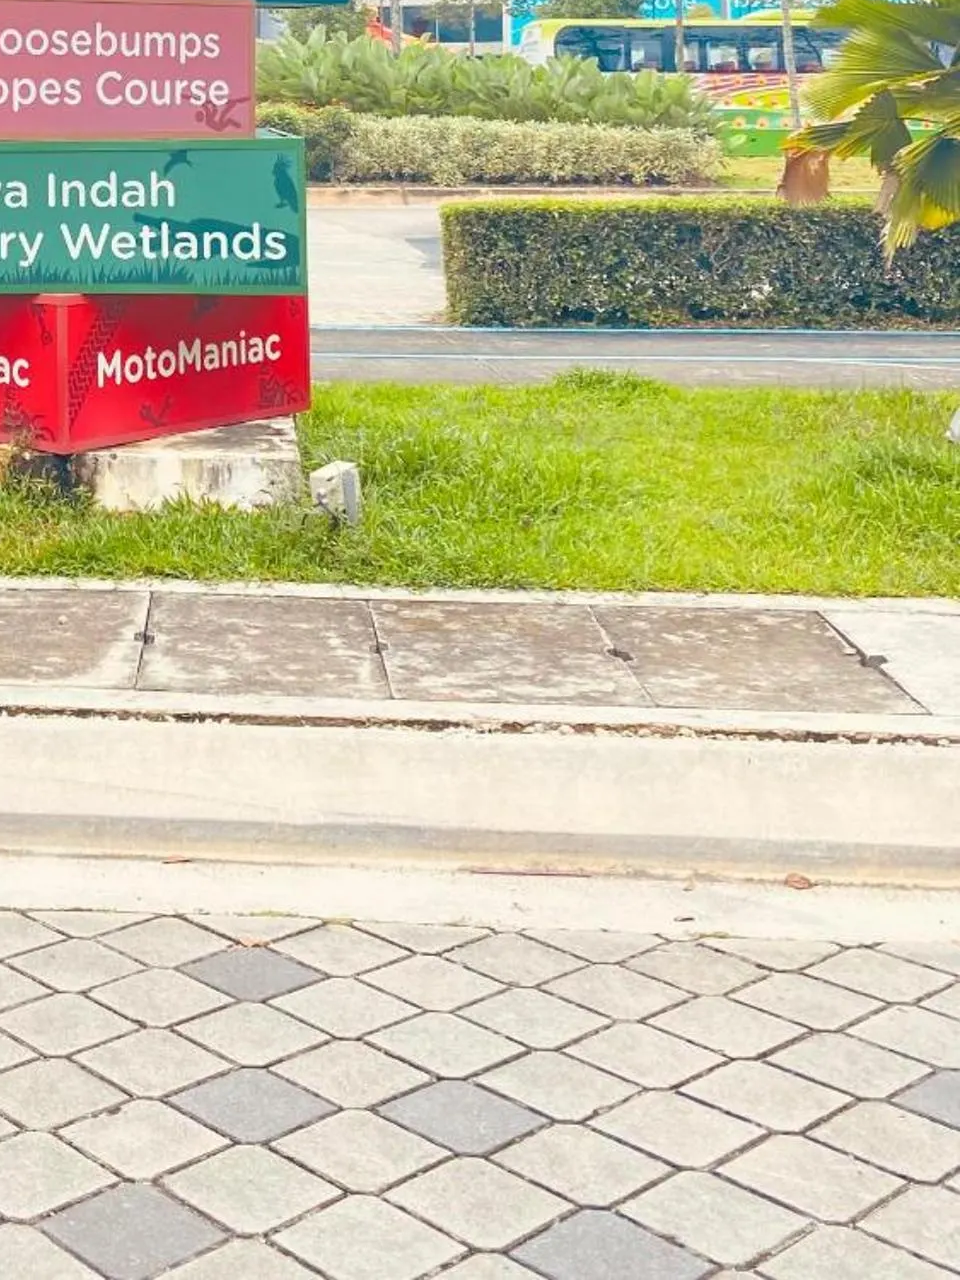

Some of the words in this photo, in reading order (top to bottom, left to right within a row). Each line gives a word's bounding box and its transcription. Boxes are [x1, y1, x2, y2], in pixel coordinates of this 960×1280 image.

[95, 70, 230, 108] Course
[47, 171, 176, 208] Indah
[58, 222, 288, 262] Wetlands
[96, 331, 282, 388] MotoManiac
